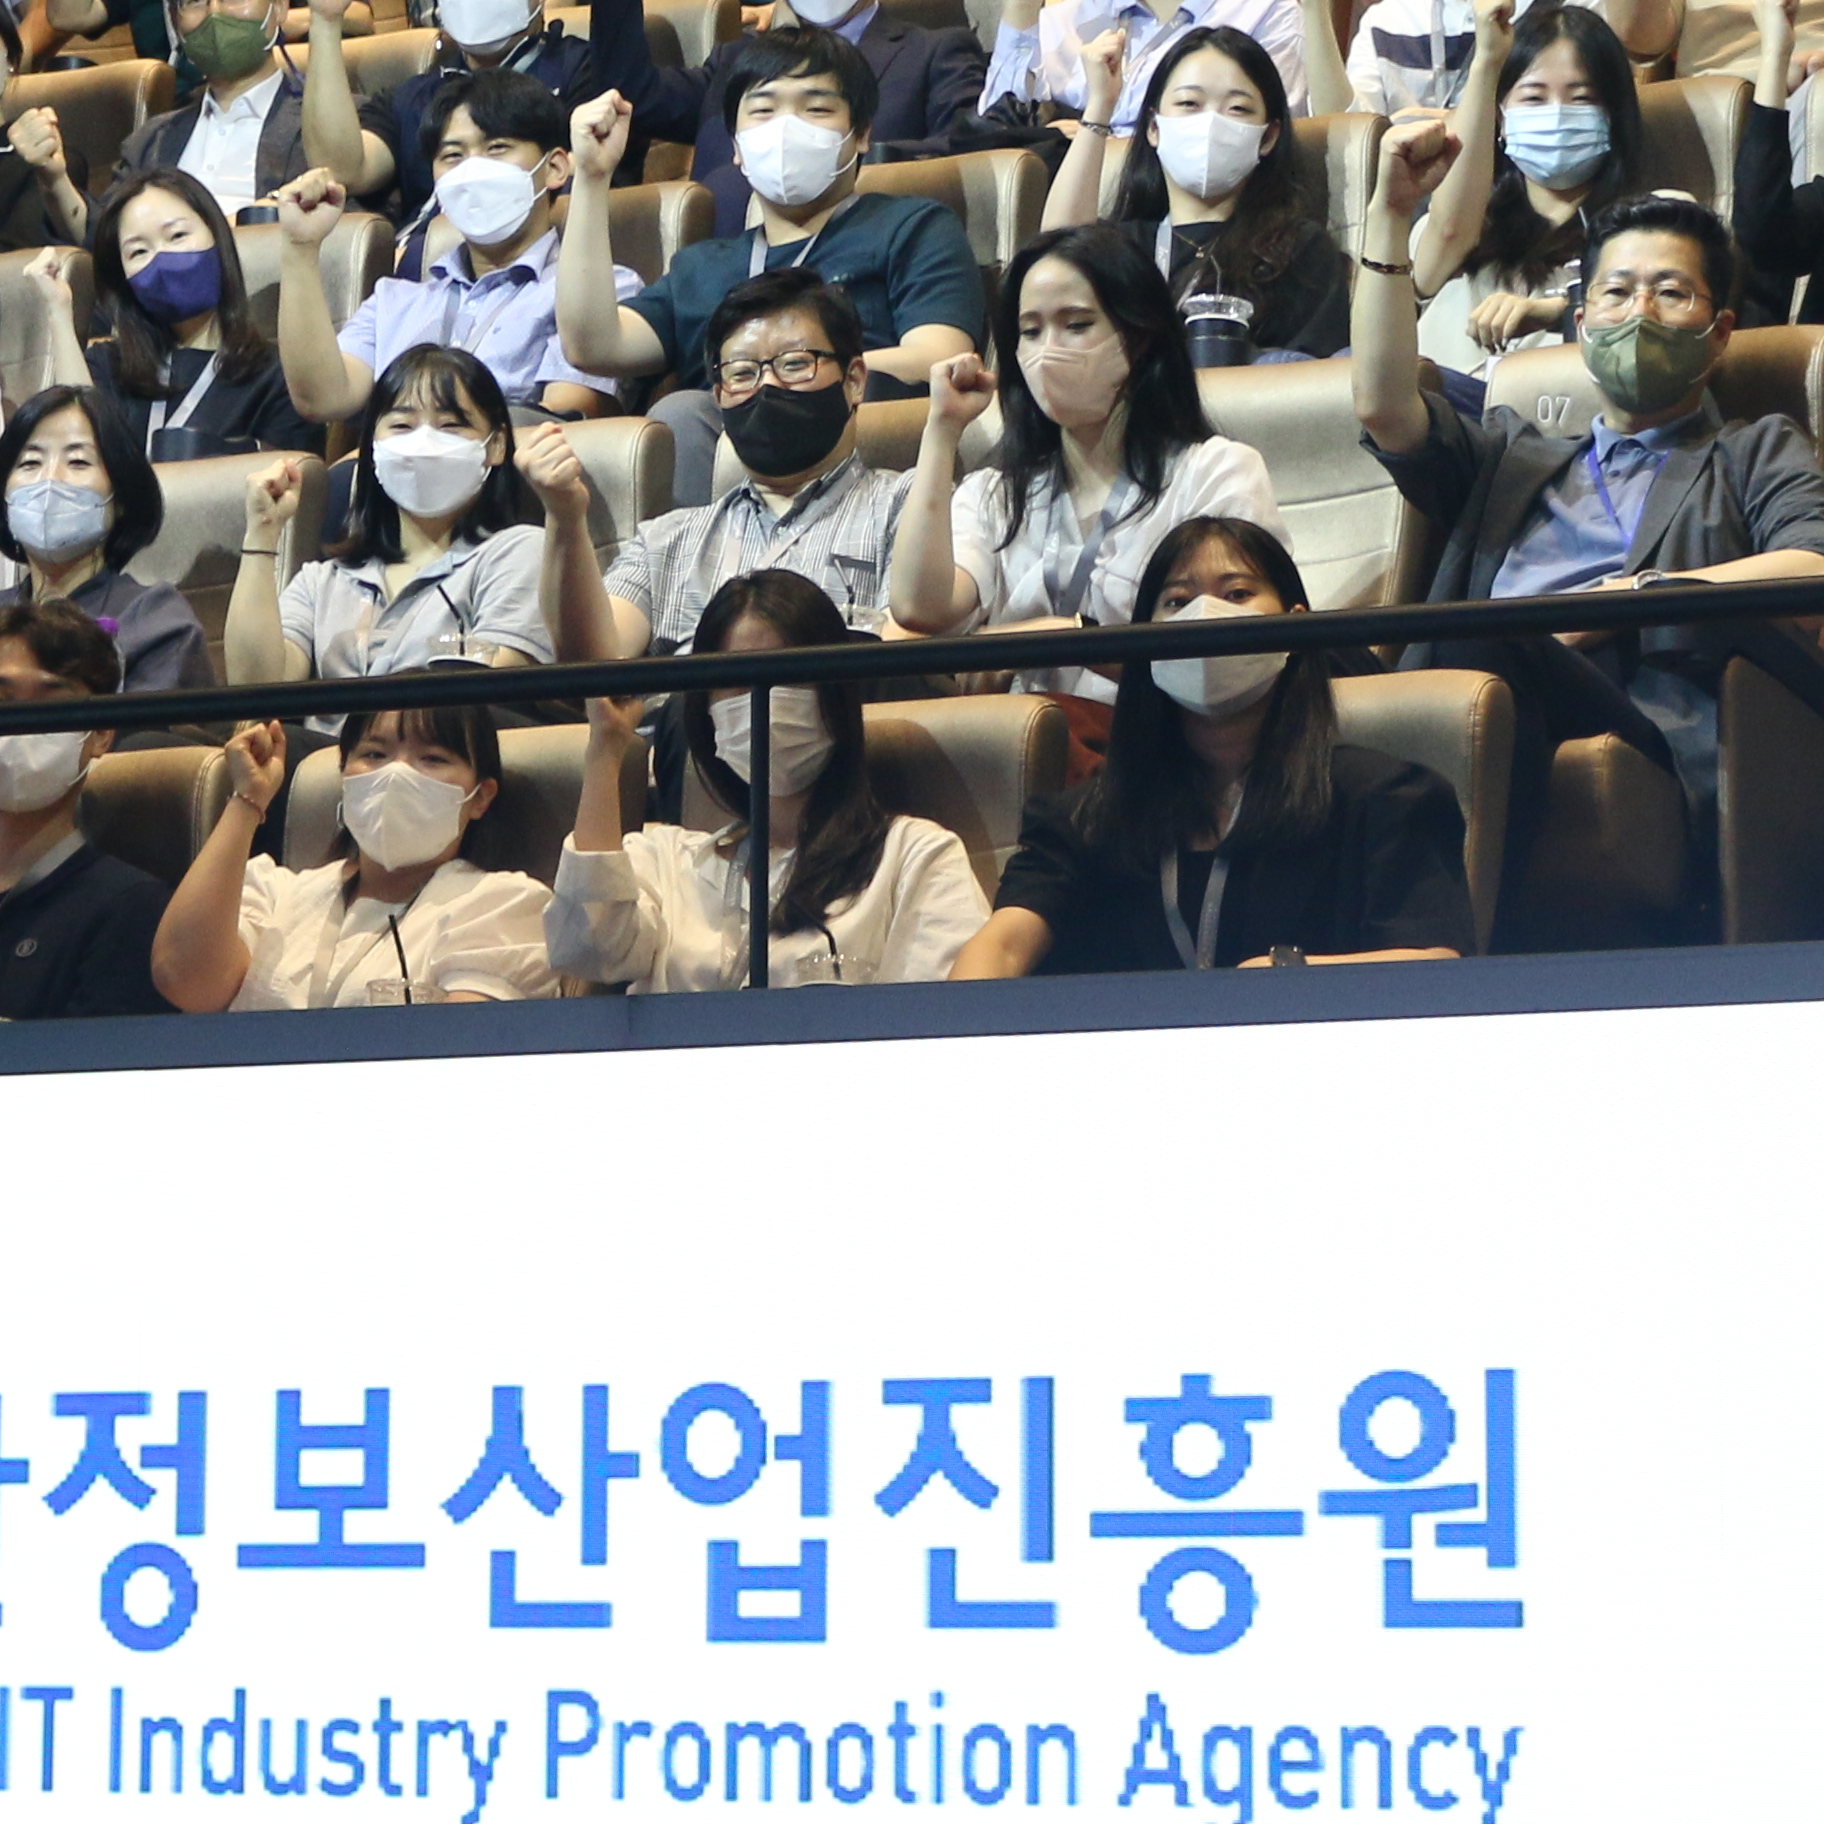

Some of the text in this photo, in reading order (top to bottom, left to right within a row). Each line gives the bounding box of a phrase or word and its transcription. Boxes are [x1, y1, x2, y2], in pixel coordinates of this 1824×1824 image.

[1536, 394, 1572, 426] 07
[108, 1685, 509, 1824] Industry
[544, 1688, 1079, 1807] Promotion
[1116, 1690, 1525, 1824] Agency
